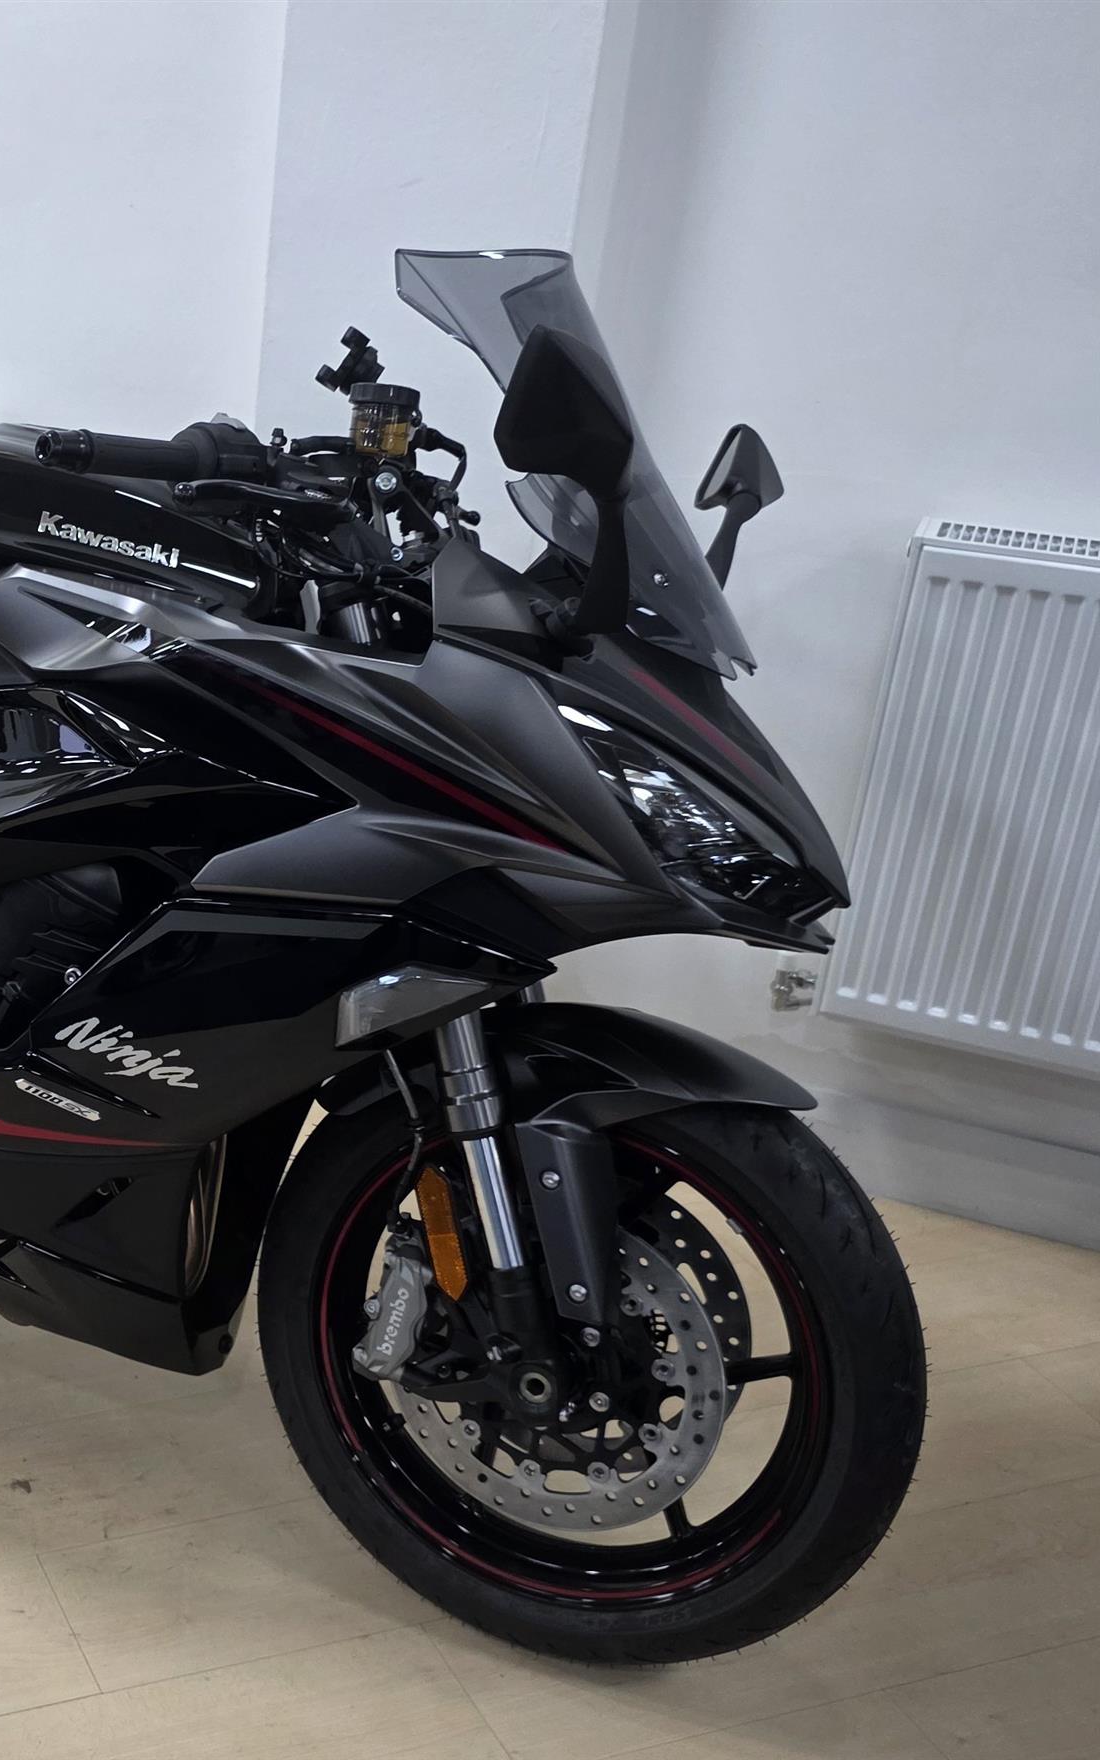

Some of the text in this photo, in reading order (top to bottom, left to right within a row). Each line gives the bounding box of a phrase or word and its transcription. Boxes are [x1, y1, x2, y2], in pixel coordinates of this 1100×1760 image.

[37, 510, 180, 568] Kawasaki
[54, 1017, 199, 1089] Ninja
[376, 1288, 409, 1356] brembo
